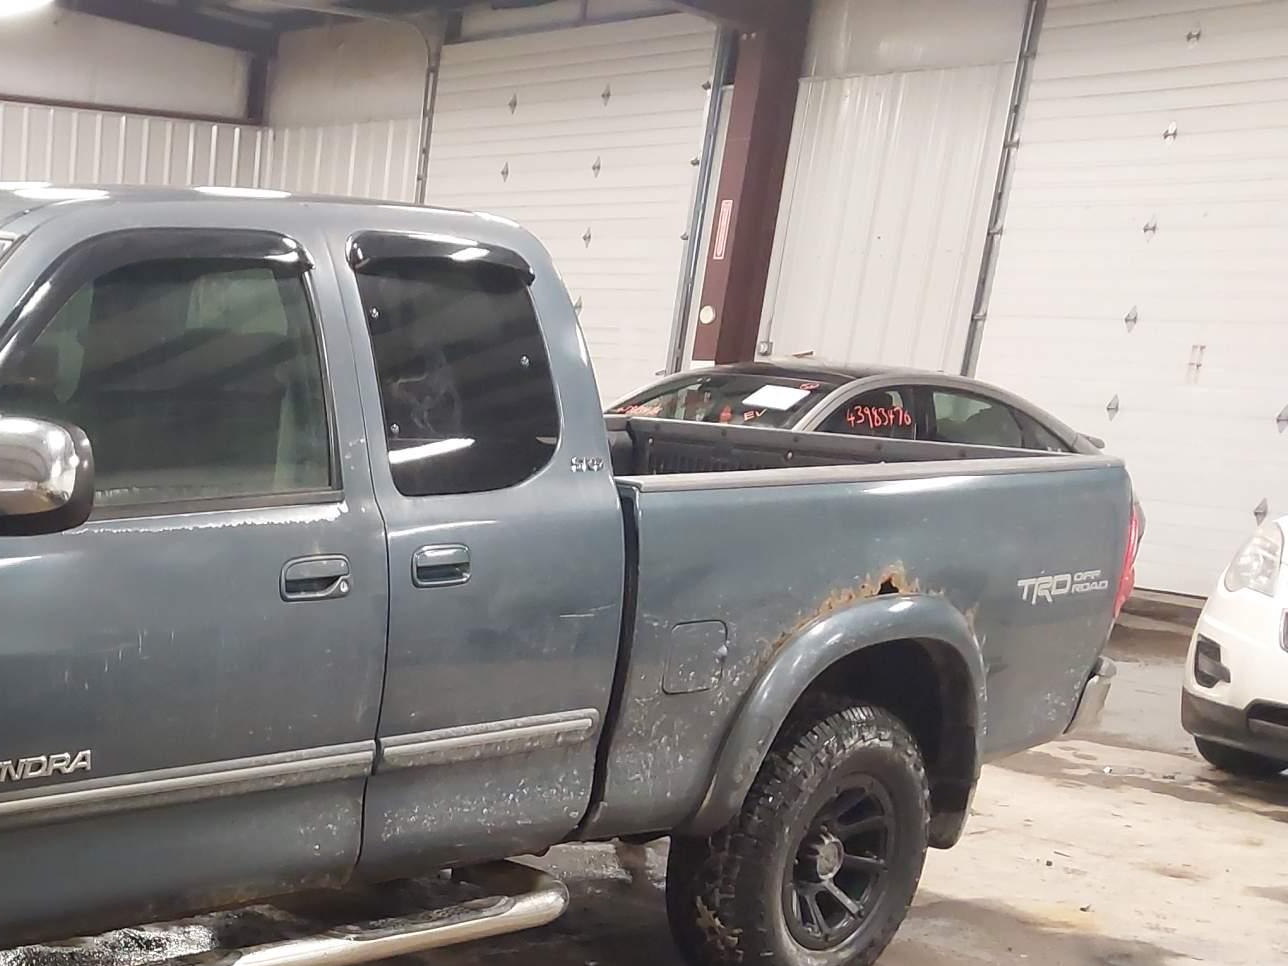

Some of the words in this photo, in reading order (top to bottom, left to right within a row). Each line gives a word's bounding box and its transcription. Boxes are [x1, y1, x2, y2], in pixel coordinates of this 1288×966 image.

[743, 408, 768, 422] EV
[1073, 570, 1102, 580] OFF
[1017, 574, 1071, 605] TRD
[1071, 580, 1109, 593] ROAD
